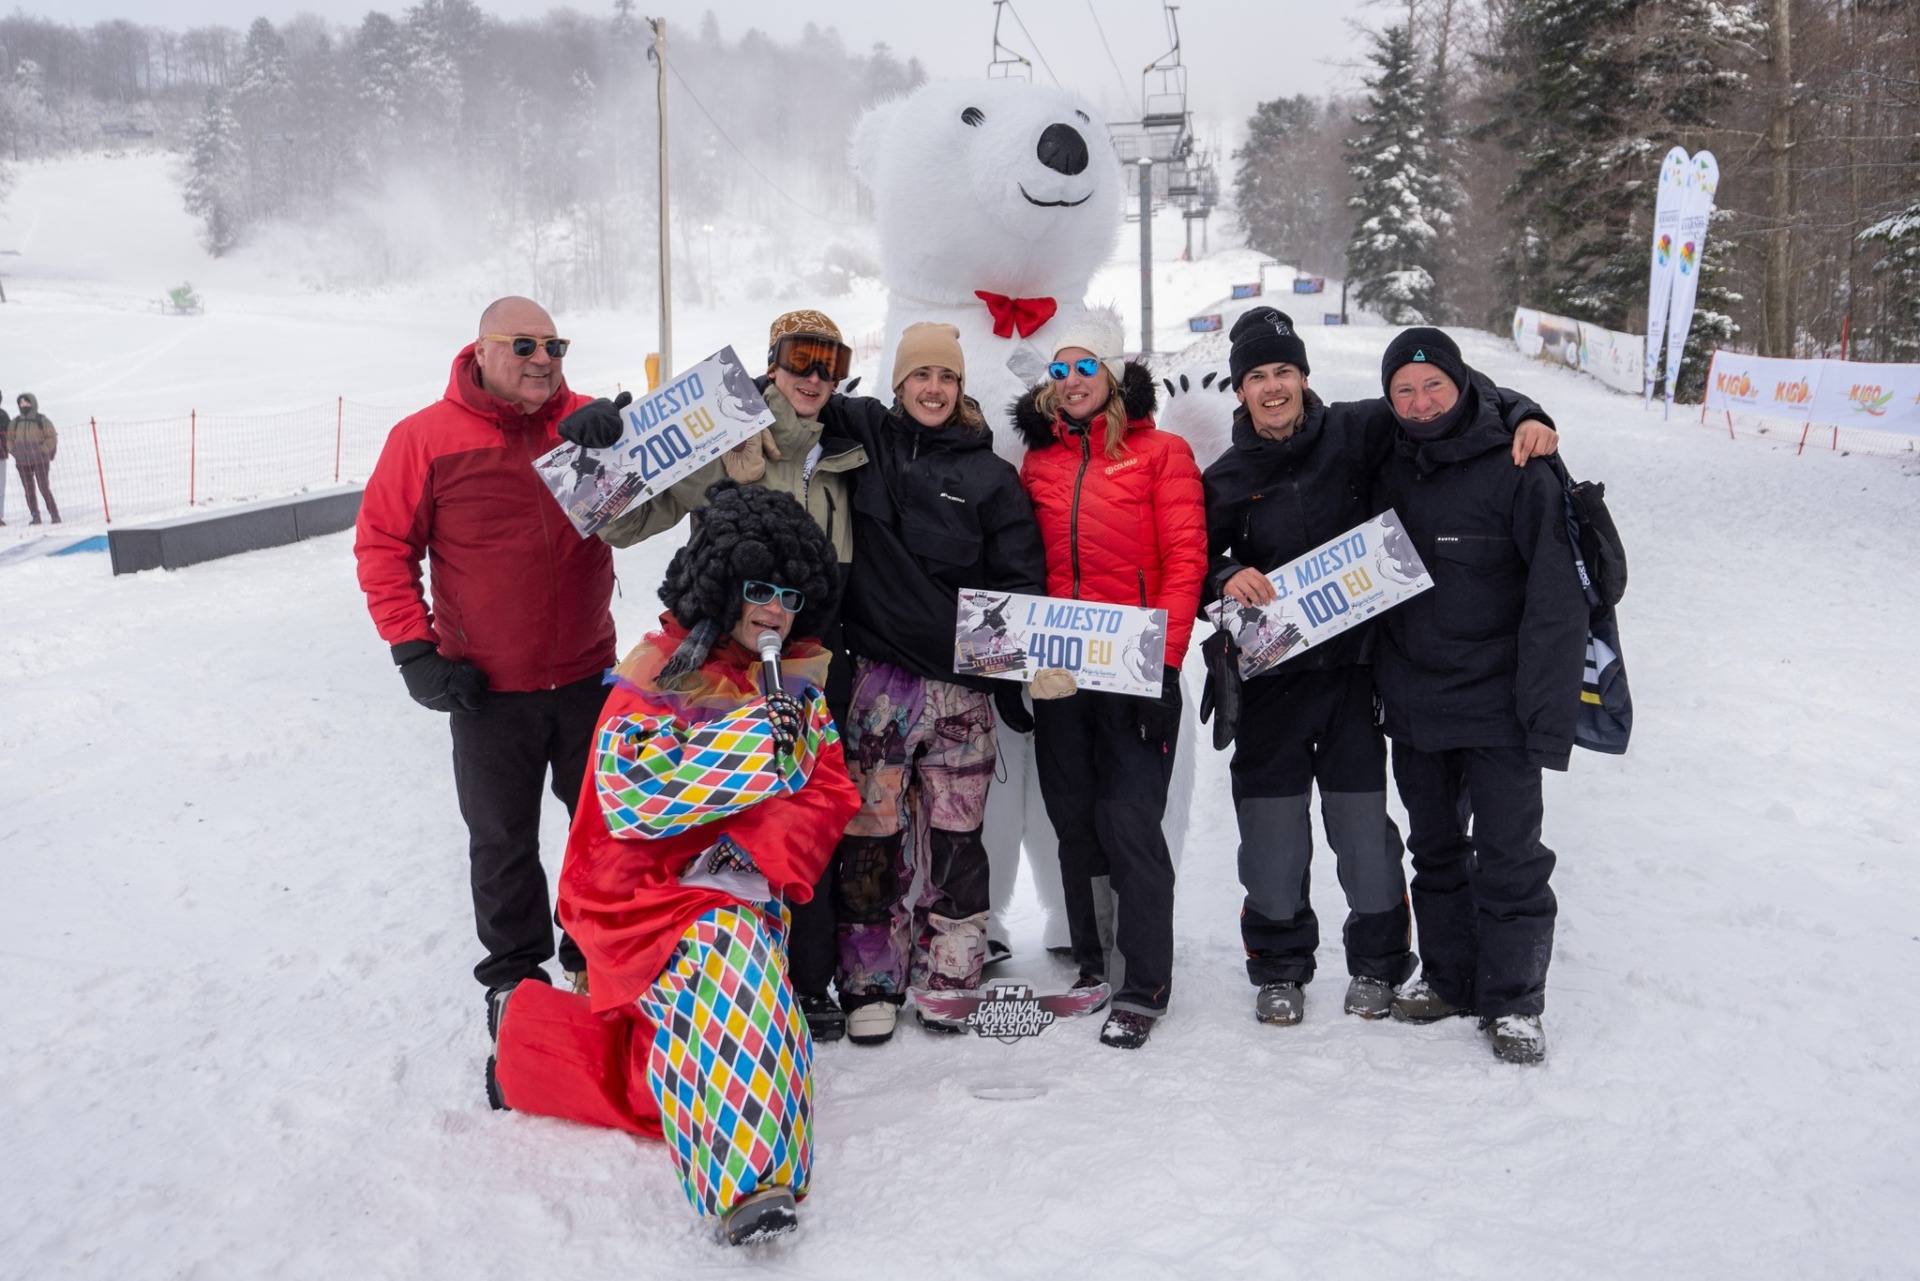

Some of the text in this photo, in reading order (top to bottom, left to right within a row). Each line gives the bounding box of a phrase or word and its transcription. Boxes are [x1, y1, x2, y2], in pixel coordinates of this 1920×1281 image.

[629, 372, 705, 437] MJESTO
[1850, 384, 1882, 403] KIGO
[628, 424, 693, 482] 200
[684, 406, 715, 440] EU
[594, 483, 630, 520] SLOPESTYLE
[1272, 532, 1367, 600] 3. MJESTO
[1297, 581, 1349, 629] 100
[1342, 566, 1373, 598] EU
[1026, 602, 1123, 634] 1. MJESTO
[972, 654, 1014, 668] SLOPESTYLE
[1028, 632, 1112, 671] 400 EU
[978, 1000, 1042, 1014] CARNIVAL
[994, 986, 1027, 1000] 14
[966, 1011, 1054, 1026] SNOWBOARD
[980, 1023, 1040, 1037] SESSION
